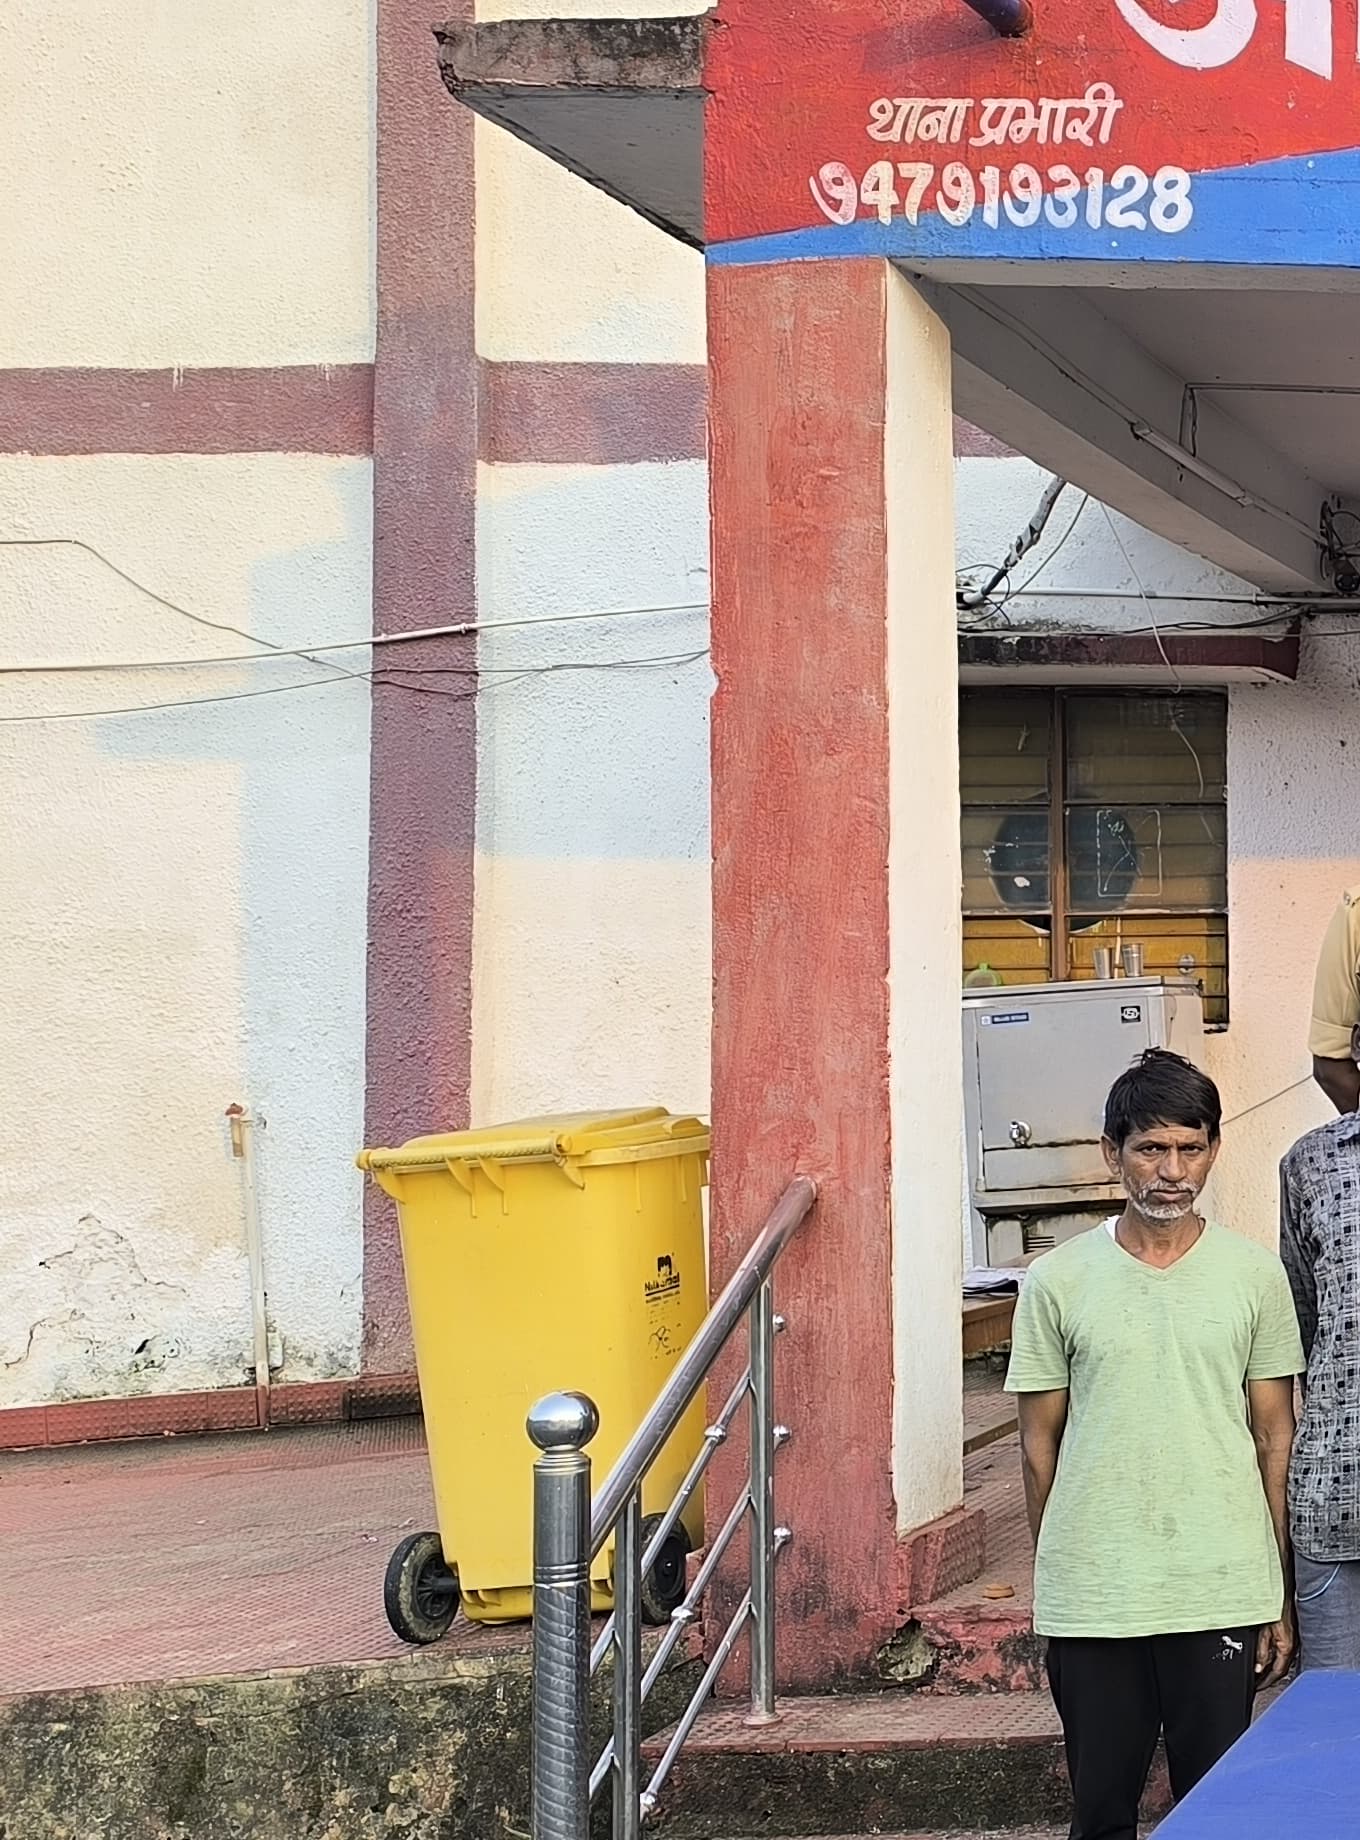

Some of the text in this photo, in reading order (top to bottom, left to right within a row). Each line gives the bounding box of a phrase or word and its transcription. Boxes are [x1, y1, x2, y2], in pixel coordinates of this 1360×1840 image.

[867, 82, 1123, 146] थाना प्रभारी
[808, 160, 1193, 233] 9479193128
